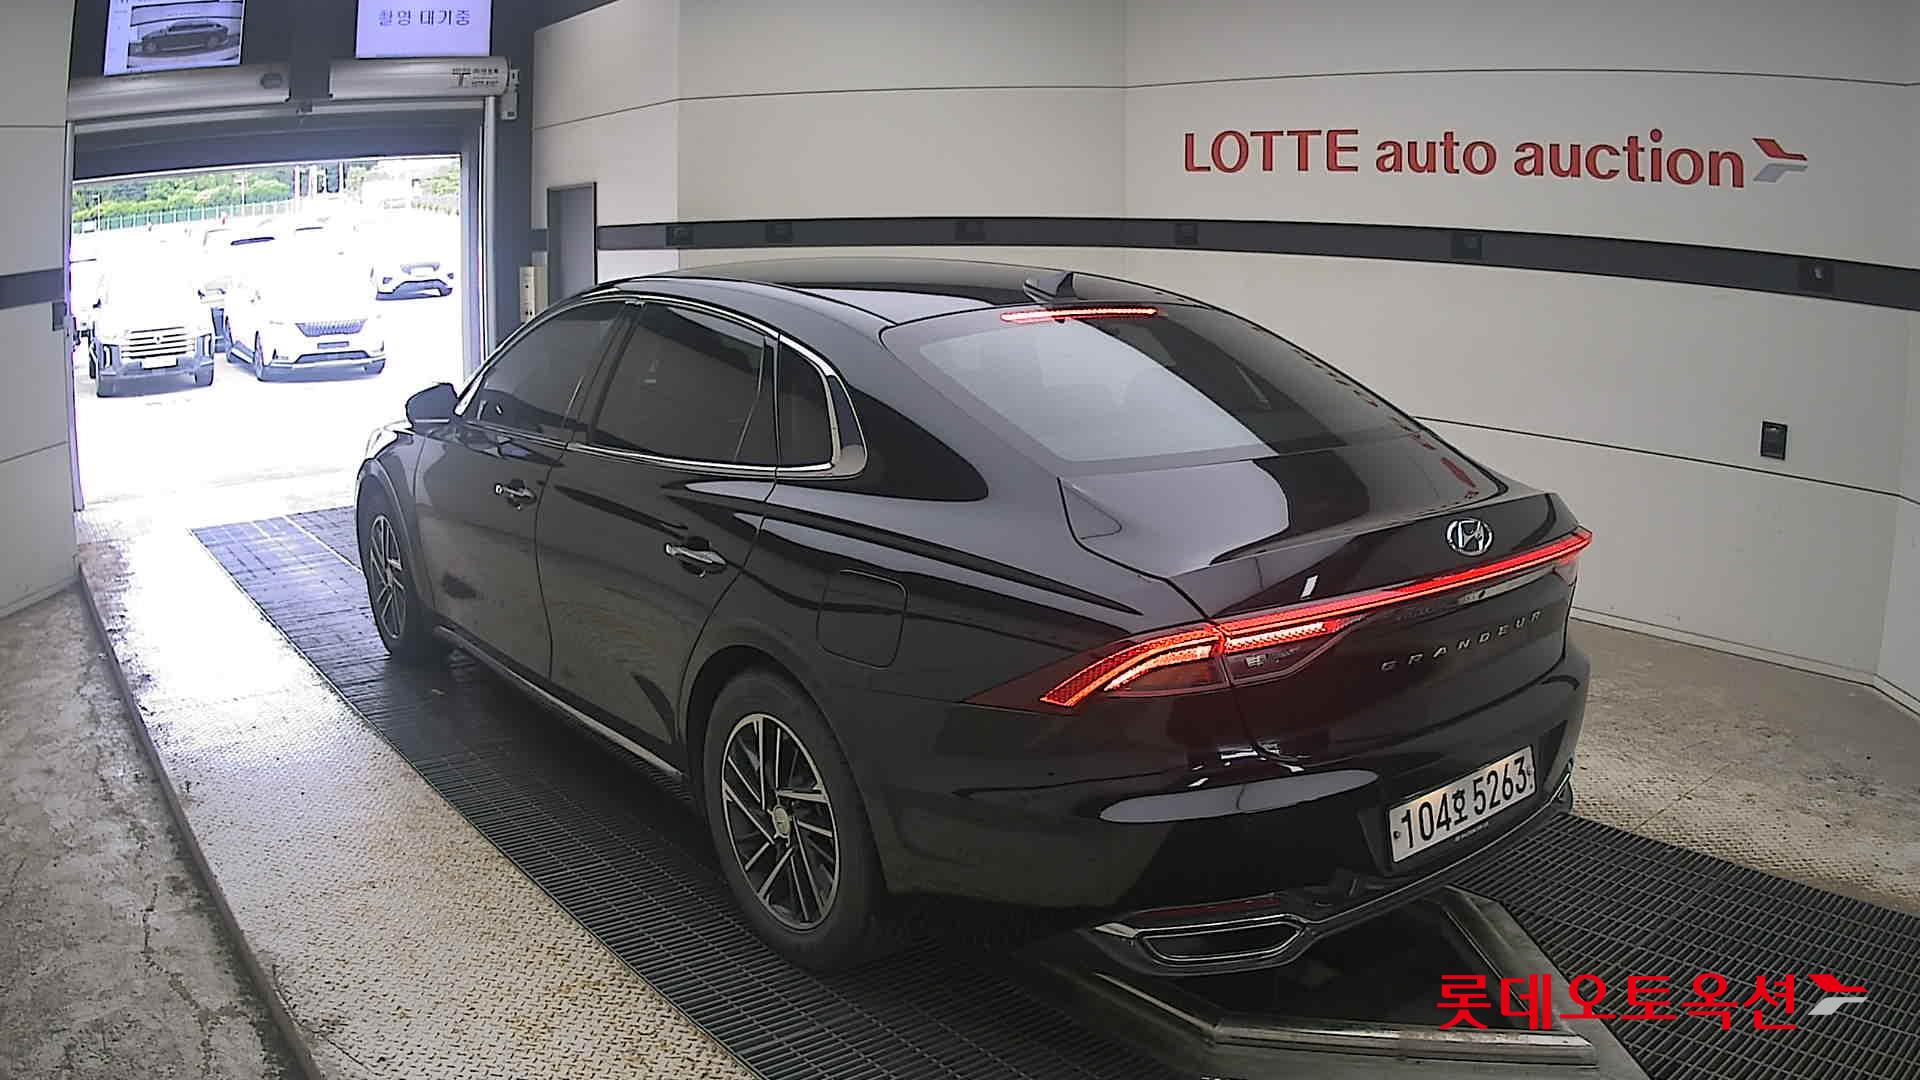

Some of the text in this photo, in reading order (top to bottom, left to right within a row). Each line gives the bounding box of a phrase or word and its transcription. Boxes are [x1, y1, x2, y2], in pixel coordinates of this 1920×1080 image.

[420, 8, 470, 26] 대기중
[1184, 129, 1744, 188] LOTTE auto auction
[1381, 610, 1542, 672] GRANDEUR
